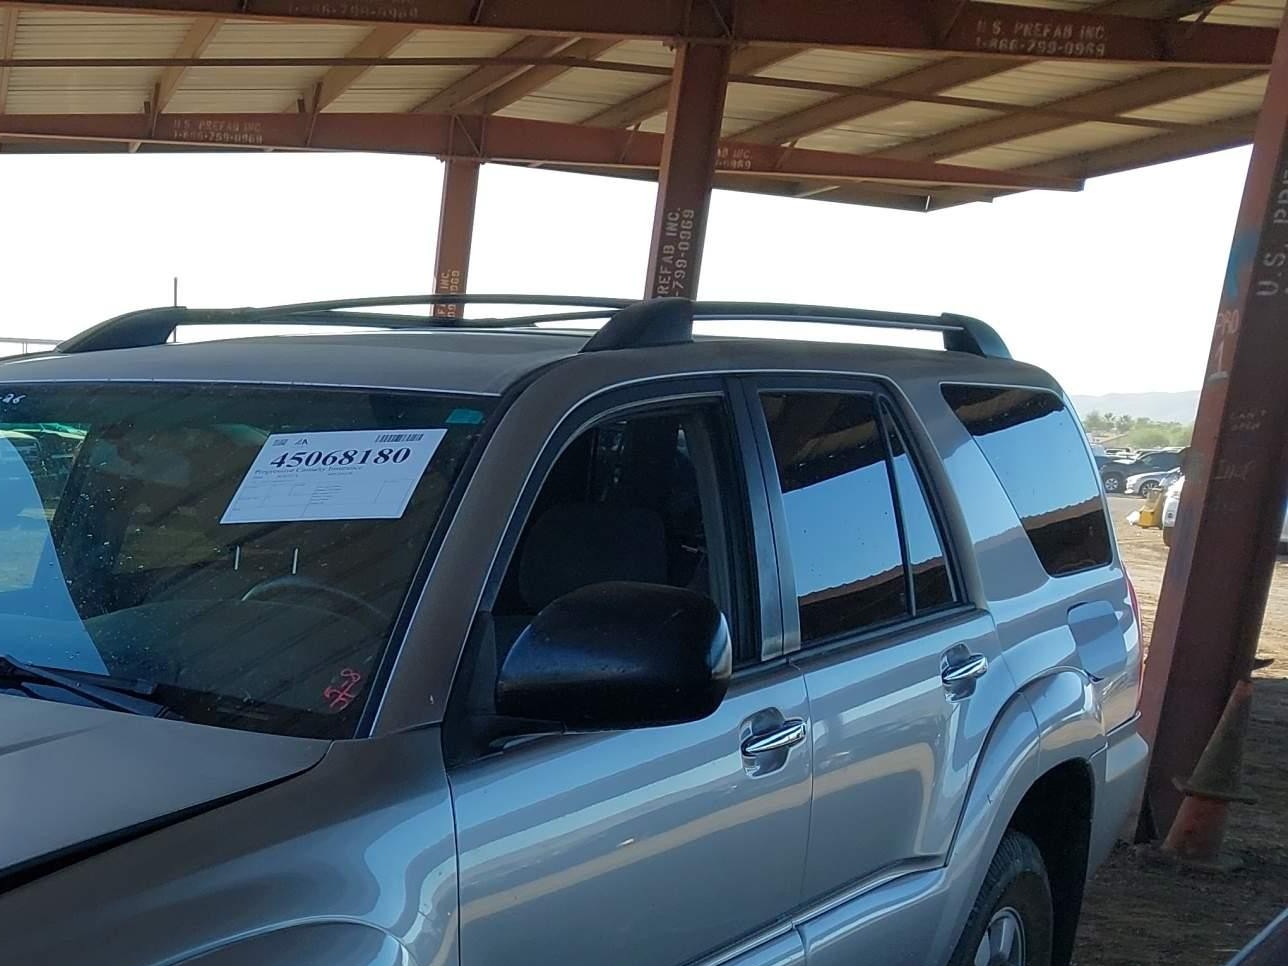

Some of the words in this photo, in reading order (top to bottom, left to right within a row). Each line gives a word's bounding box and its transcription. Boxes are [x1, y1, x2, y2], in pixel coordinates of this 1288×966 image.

[1014, 22, 1073, 39] PREFAB
[665, 207, 681, 237] INC.
[270, 447, 411, 467] 45068180
